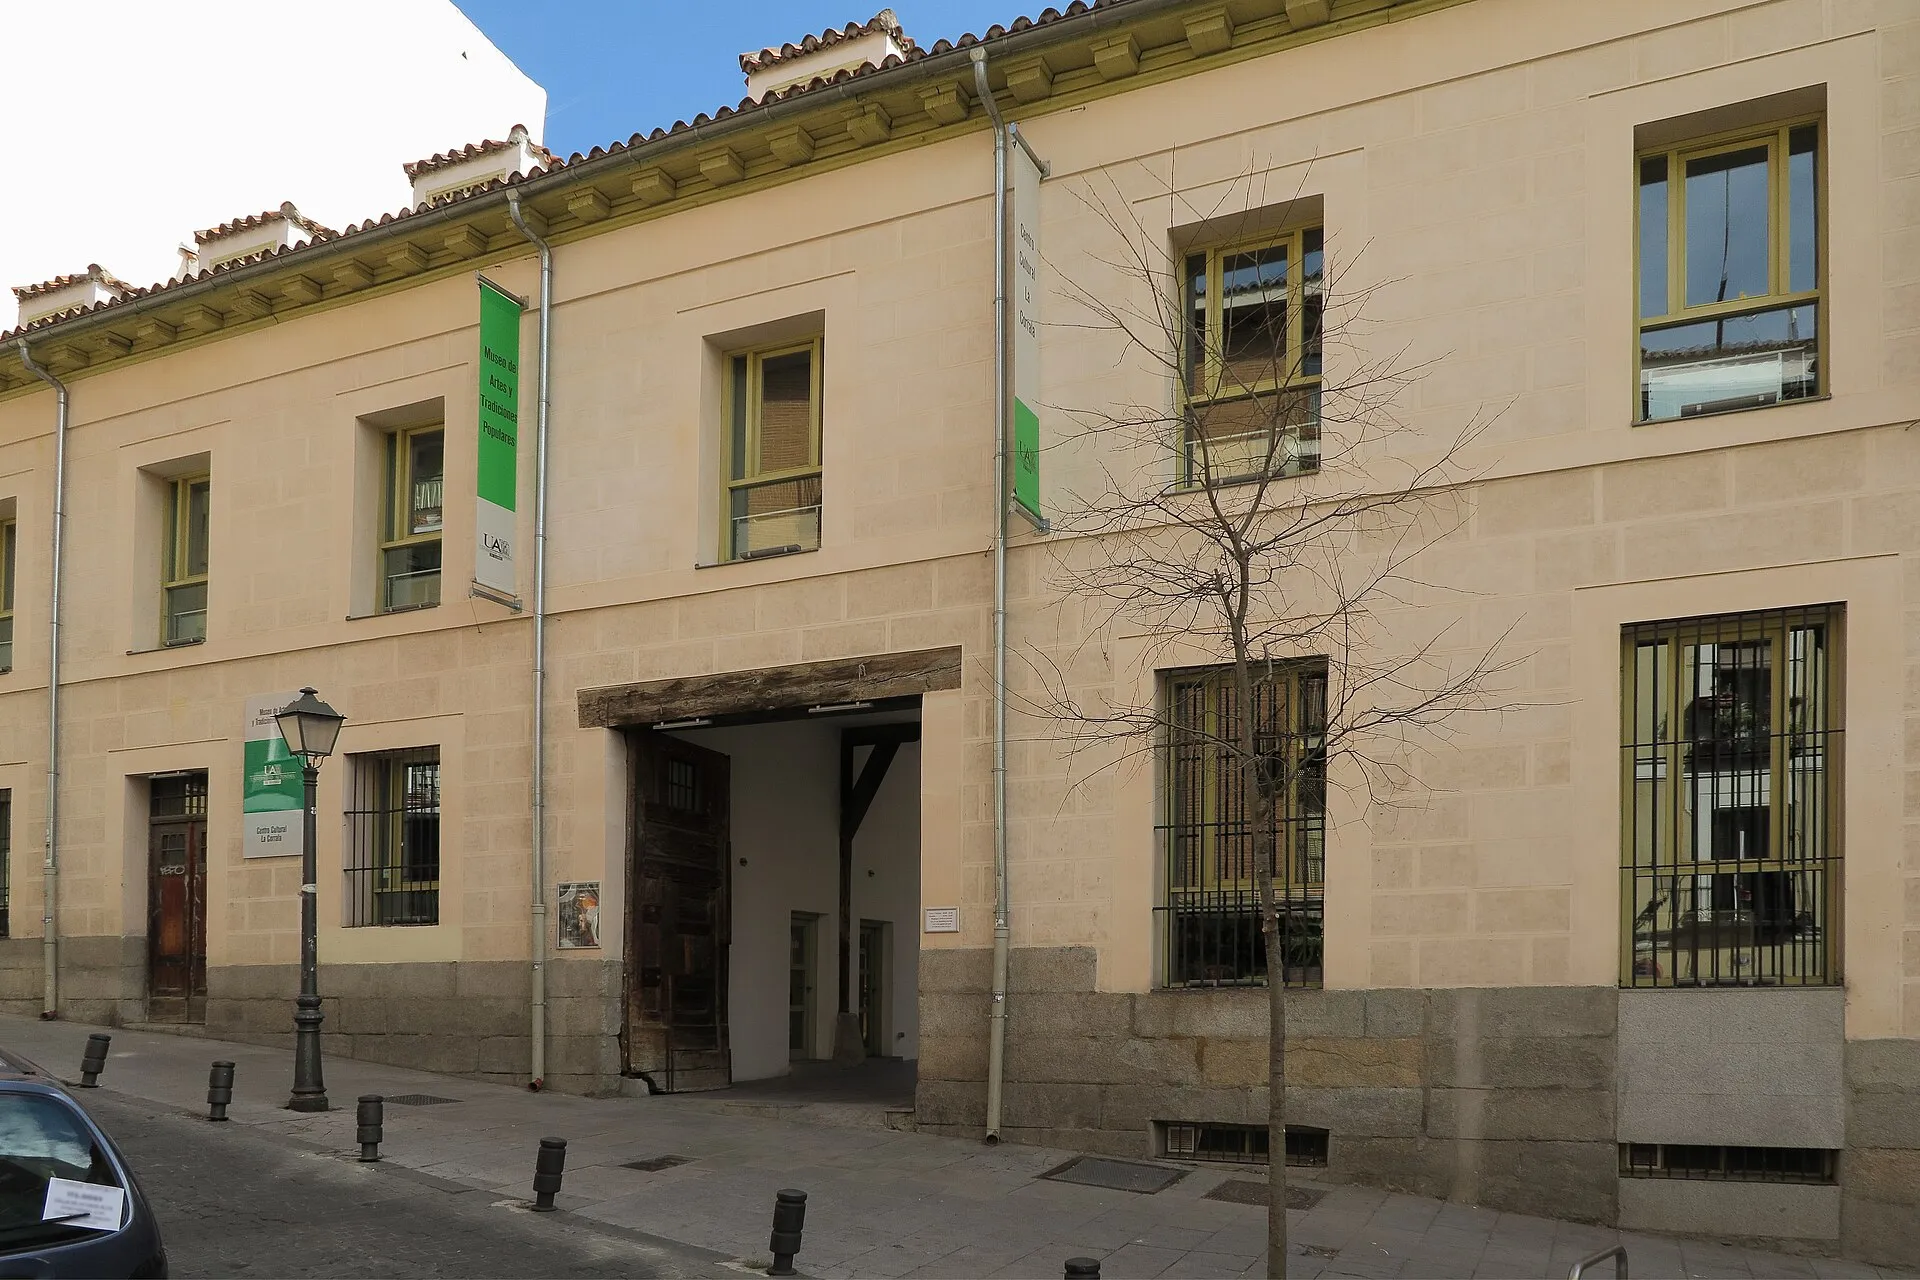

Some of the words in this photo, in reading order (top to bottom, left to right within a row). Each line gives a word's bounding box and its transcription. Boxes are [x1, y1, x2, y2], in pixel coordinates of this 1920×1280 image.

[1020, 222, 1035, 251] Centro
[1019, 250, 1036, 281] Cultural
[1024, 285, 1031, 304] La
[484, 345, 507, 369] Museo
[508, 360, 518, 376] de
[489, 374, 507, 394] Artes
[507, 386, 513, 398] y
[480, 393, 518, 424] Tradiciones
[482, 420, 516, 447] Populares
[256, 826, 270, 834] Centro
[270, 824, 288, 833] Cultural
[260, 835, 266, 843] La
